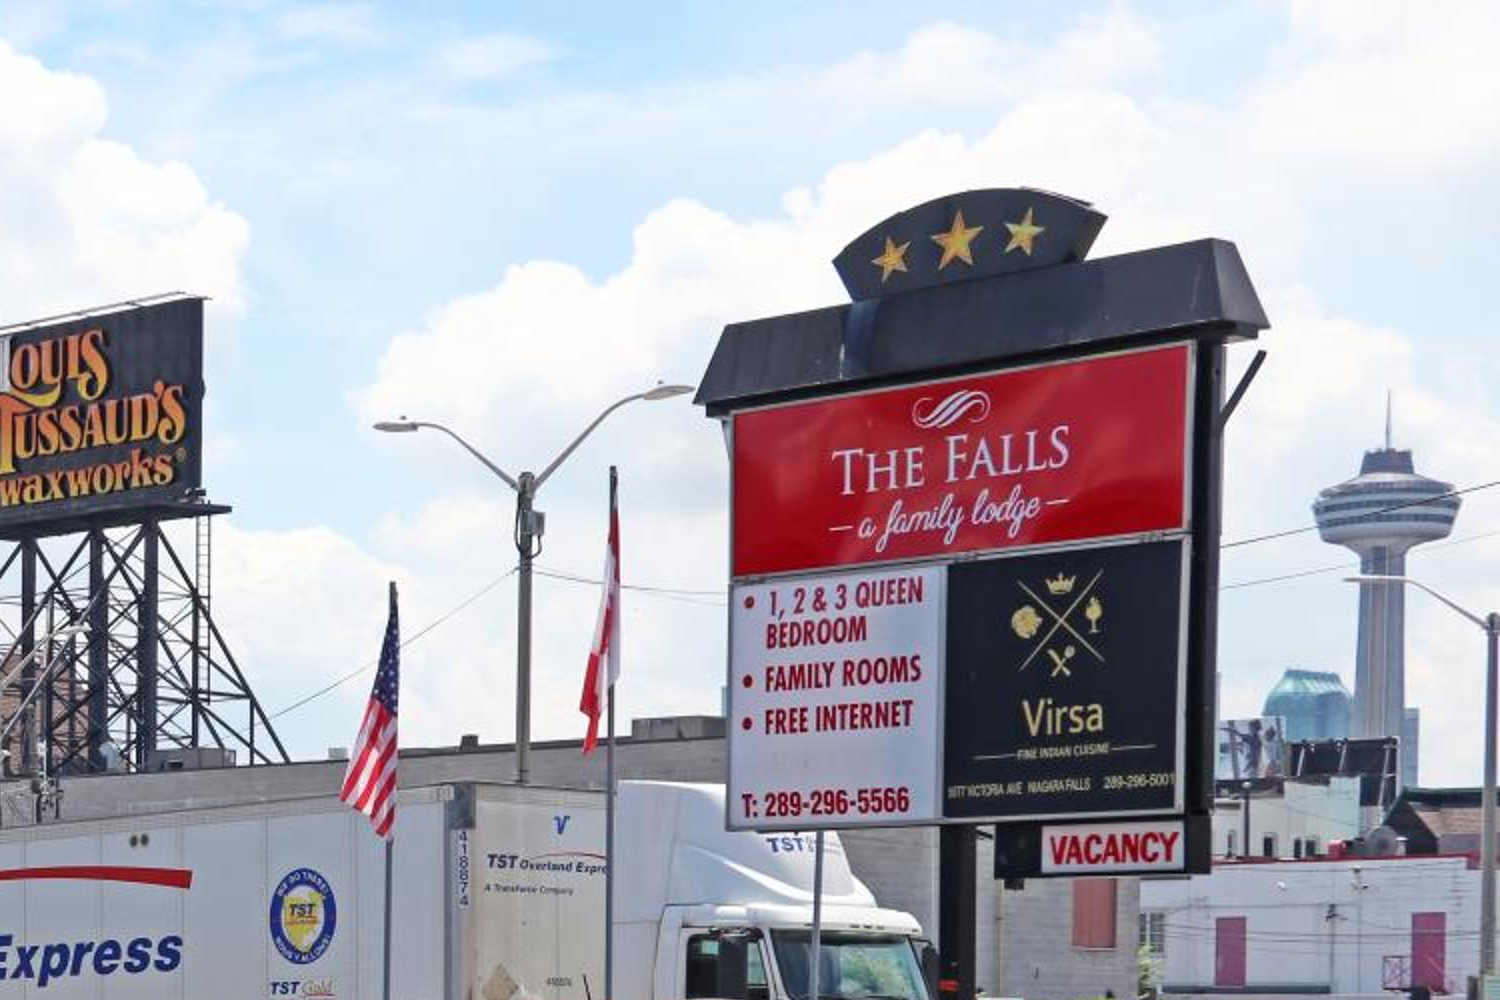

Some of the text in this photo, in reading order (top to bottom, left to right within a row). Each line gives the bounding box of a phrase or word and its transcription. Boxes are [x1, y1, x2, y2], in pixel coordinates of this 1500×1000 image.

[831, 425, 1070, 496] THE FALLS
[858, 484, 1041, 553] a family lodge
[793, 588, 806, 614] 2
[811, 587, 827, 613] &
[835, 584, 847, 610] 3
[855, 576, 924, 609] QUEEN
[766, 615, 867, 649] BEDROOM
[765, 655, 922, 693] FAMILY ROOMS
[765, 700, 914, 735] FREE INTERNET
[1021, 698, 1104, 737] Virsa
[1065, 776, 1091, 792] FALLS
[741, 786, 910, 818] T: 289-296-5566
[766, 836, 804, 853] TST
[1050, 831, 1180, 865] VACANCY
[487, 854, 608, 876] TST Overland Expr
[289, 903, 316, 918] TST
[270, 981, 301, 996] TST
